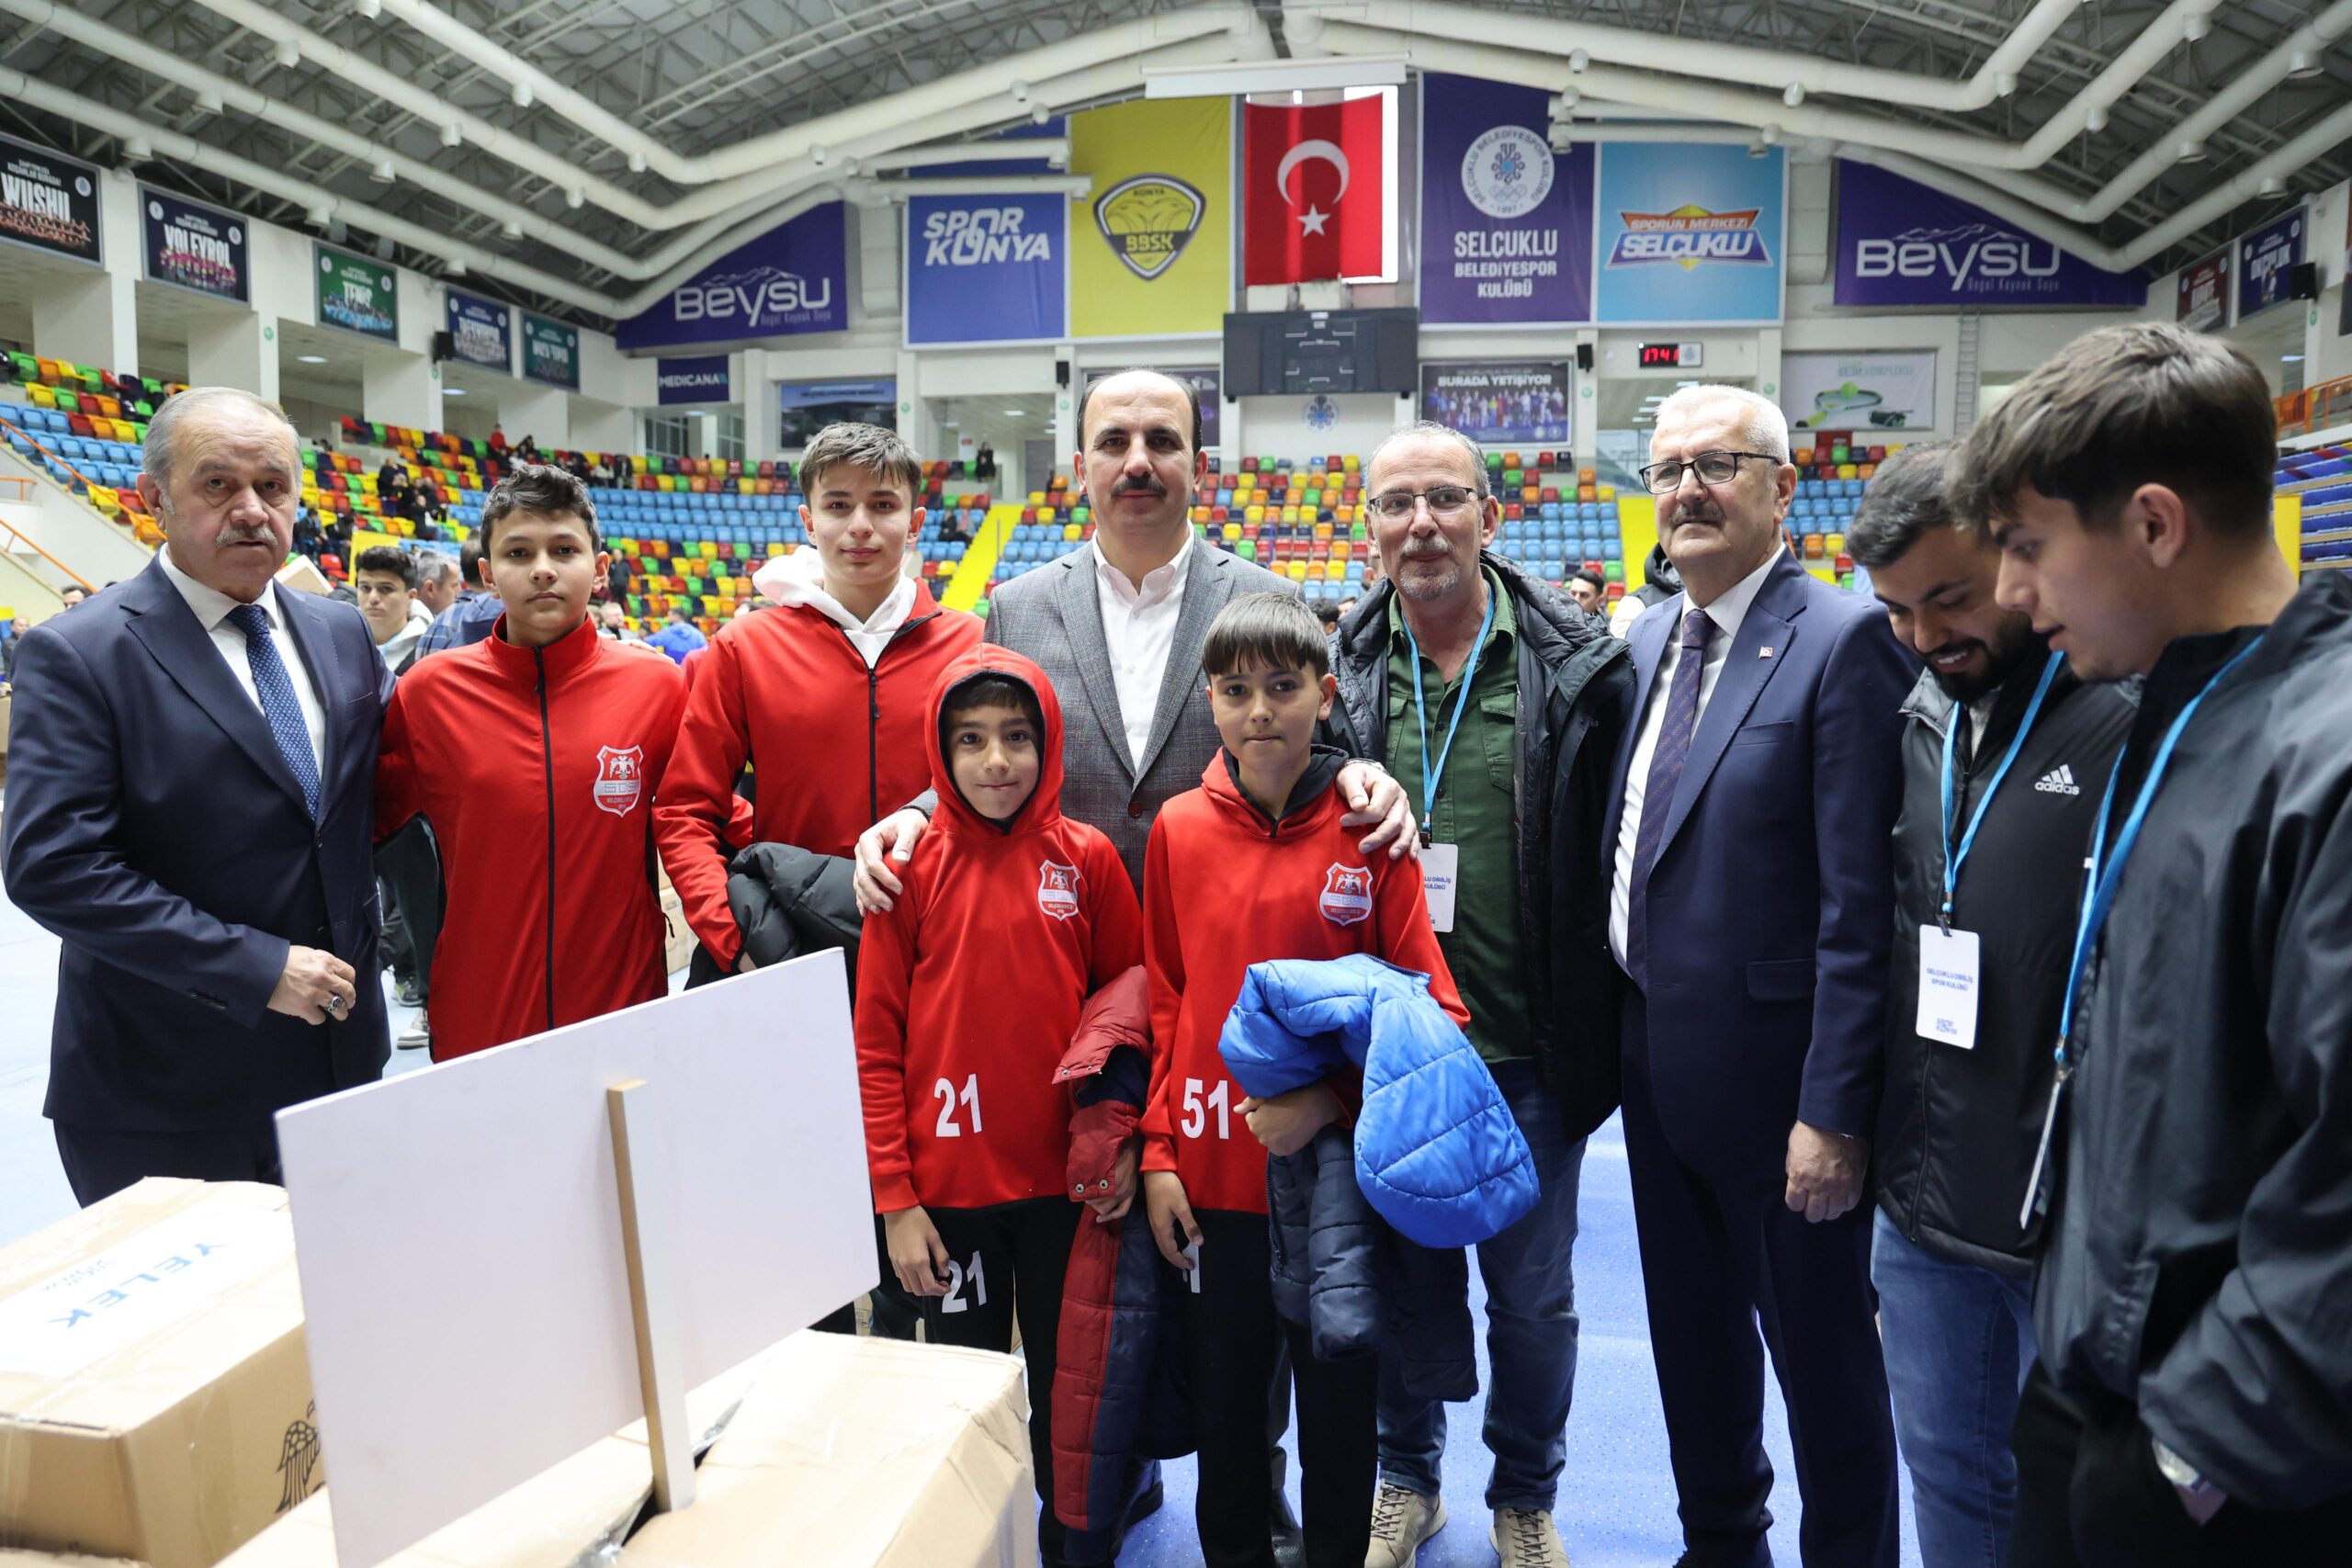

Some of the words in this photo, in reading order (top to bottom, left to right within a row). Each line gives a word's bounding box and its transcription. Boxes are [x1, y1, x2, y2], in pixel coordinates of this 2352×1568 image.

[922, 207, 1024, 244] SPOR
[1630, 218, 1687, 230] SPORUN
[924, 228, 1051, 266] KONYA
[1125, 233, 1175, 252] BBSK
[1453, 229, 1558, 259] SELÇUKLU
[1620, 232, 1754, 259] SELÇUKLU
[1476, 277, 1532, 299] KULÜBÜ
[659, 372, 721, 389] MEDICANA
[1438, 375, 1489, 388] BURADA
[2034, 780, 2080, 795] adidas
[933, 1073, 982, 1138] 21
[1181, 1077, 1230, 1140] 51
[45, 1243, 227, 1328] YELEK
[941, 1249, 988, 1314] 21
